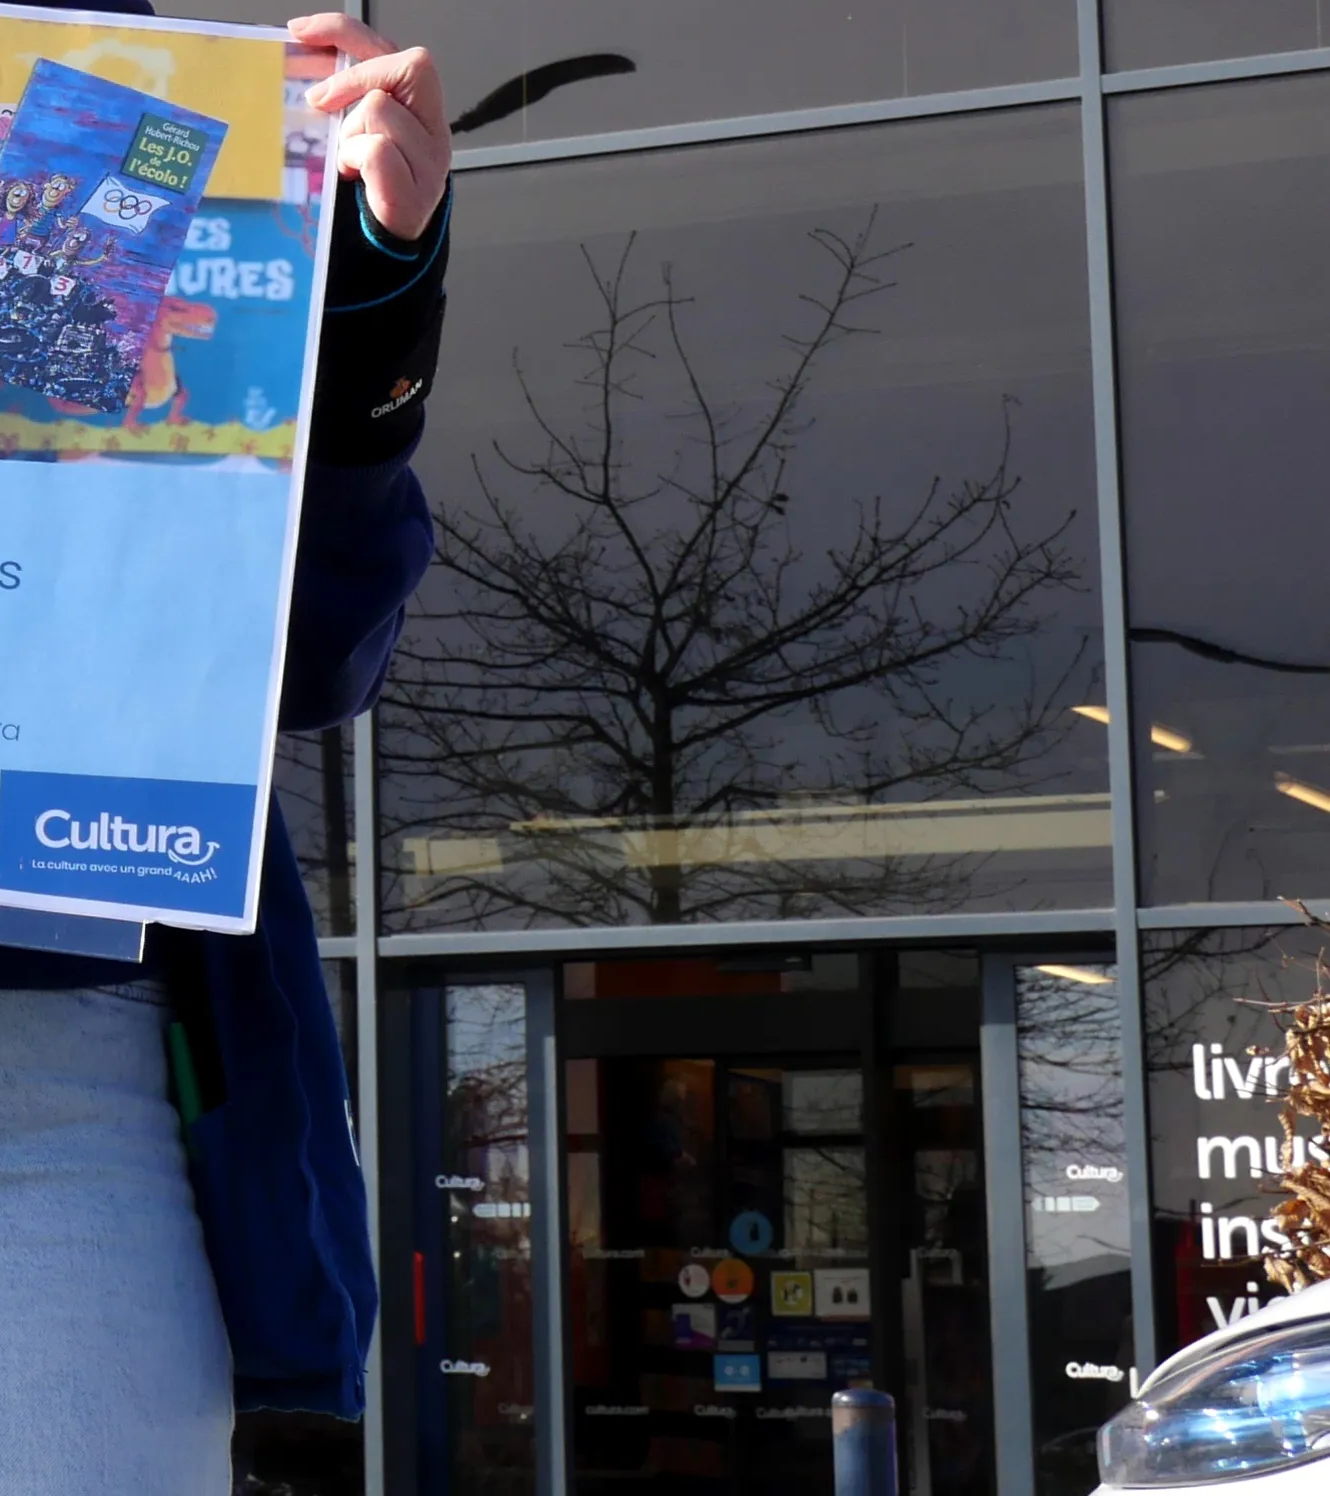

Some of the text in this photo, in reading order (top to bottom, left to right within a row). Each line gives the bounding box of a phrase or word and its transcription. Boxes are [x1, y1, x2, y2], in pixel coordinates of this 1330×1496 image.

[139, 137, 193, 167] Les J.O.
[149, 156, 161, 167] de
[34, 808, 202, 856] Cultura
[32, 859, 46, 869] La
[47, 860, 87, 871] culture
[89, 863, 118, 873] avec
[120, 864, 135, 874] un
[137, 865, 173, 877] grand
[1066, 1164, 1123, 1183] Cultura
[434, 1174, 485, 1192] Cultura
[439, 1359, 490, 1377] Cultura
[1065, 1361, 1124, 1381] Cultura
